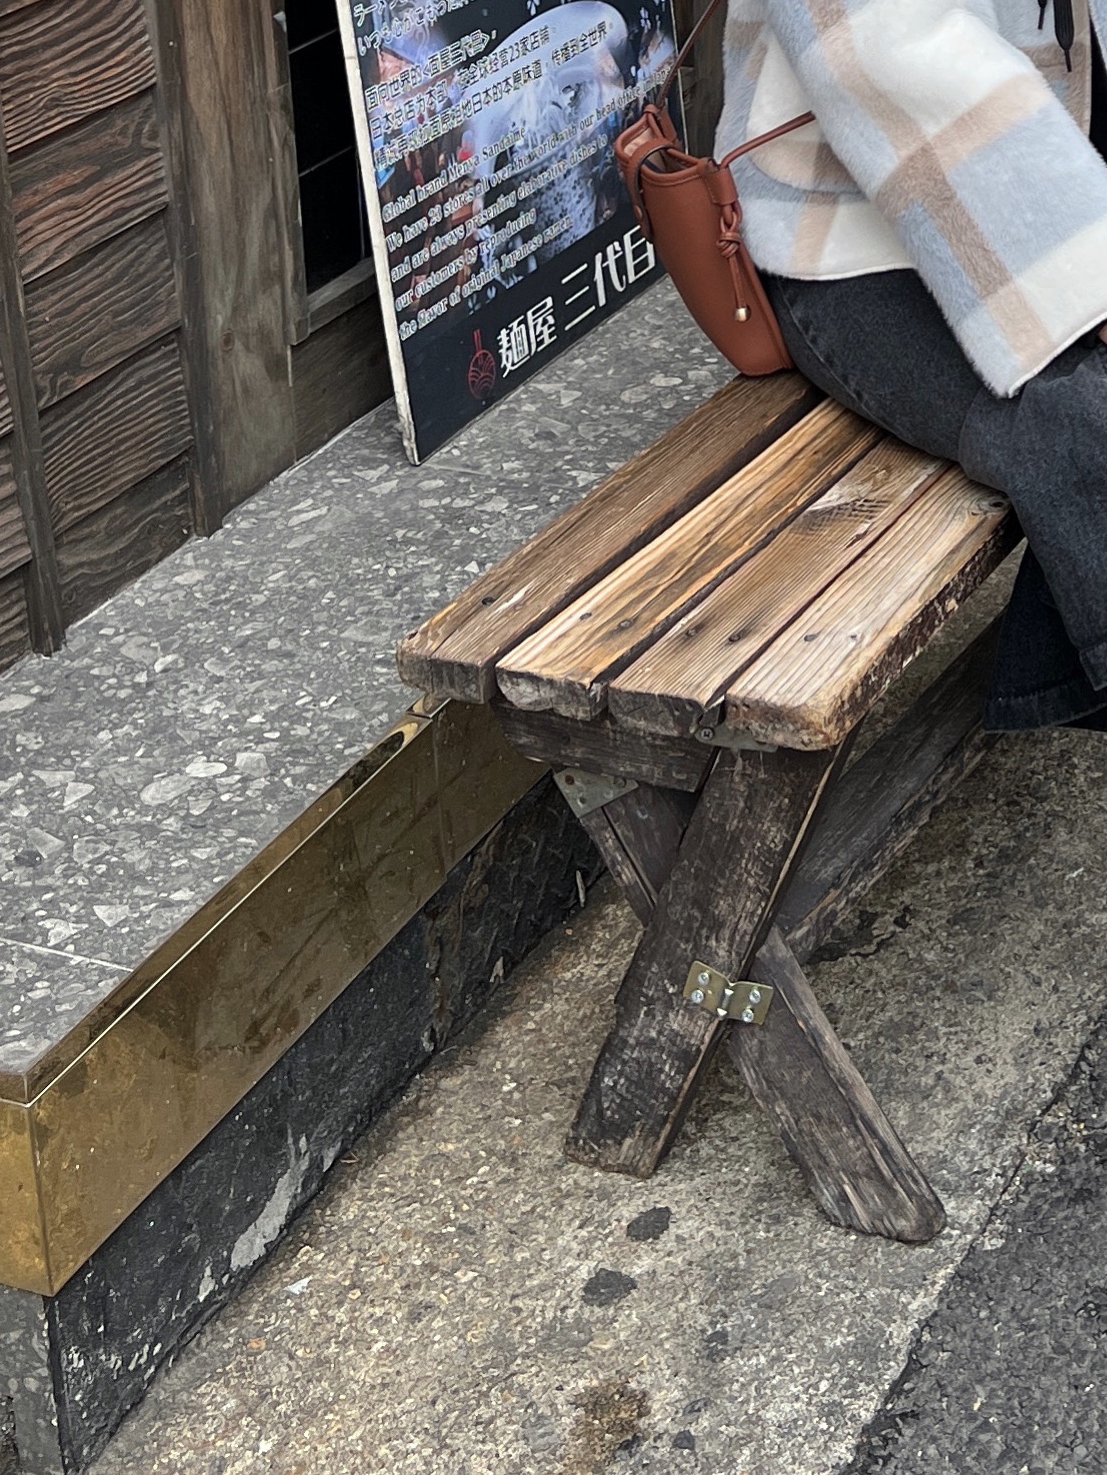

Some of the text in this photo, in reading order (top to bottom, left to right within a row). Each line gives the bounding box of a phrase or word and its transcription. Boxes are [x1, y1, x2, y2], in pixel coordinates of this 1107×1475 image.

[382, 123, 526, 222] Global brand Menya Sandaime
[386, 229, 403, 251] We
[403, 213, 429, 240] have
[443, 186, 474, 215] stores
[474, 176, 489, 195] all
[491, 165, 513, 185] over
[513, 153, 529, 170] the
[528, 134, 559, 161] world
[580, 114, 594, 129] our
[596, 99, 616, 119] head
[617, 83, 640, 108] office
[390, 131, 609, 281] and are always presenting elaborative dishes to
[395, 205, 537, 310] our customers by reproducing
[399, 316, 417, 339] the
[417, 295, 449, 328] flavor
[448, 285, 463, 306] of
[461, 260, 500, 299] original
[500, 231, 543, 272] Japanese
